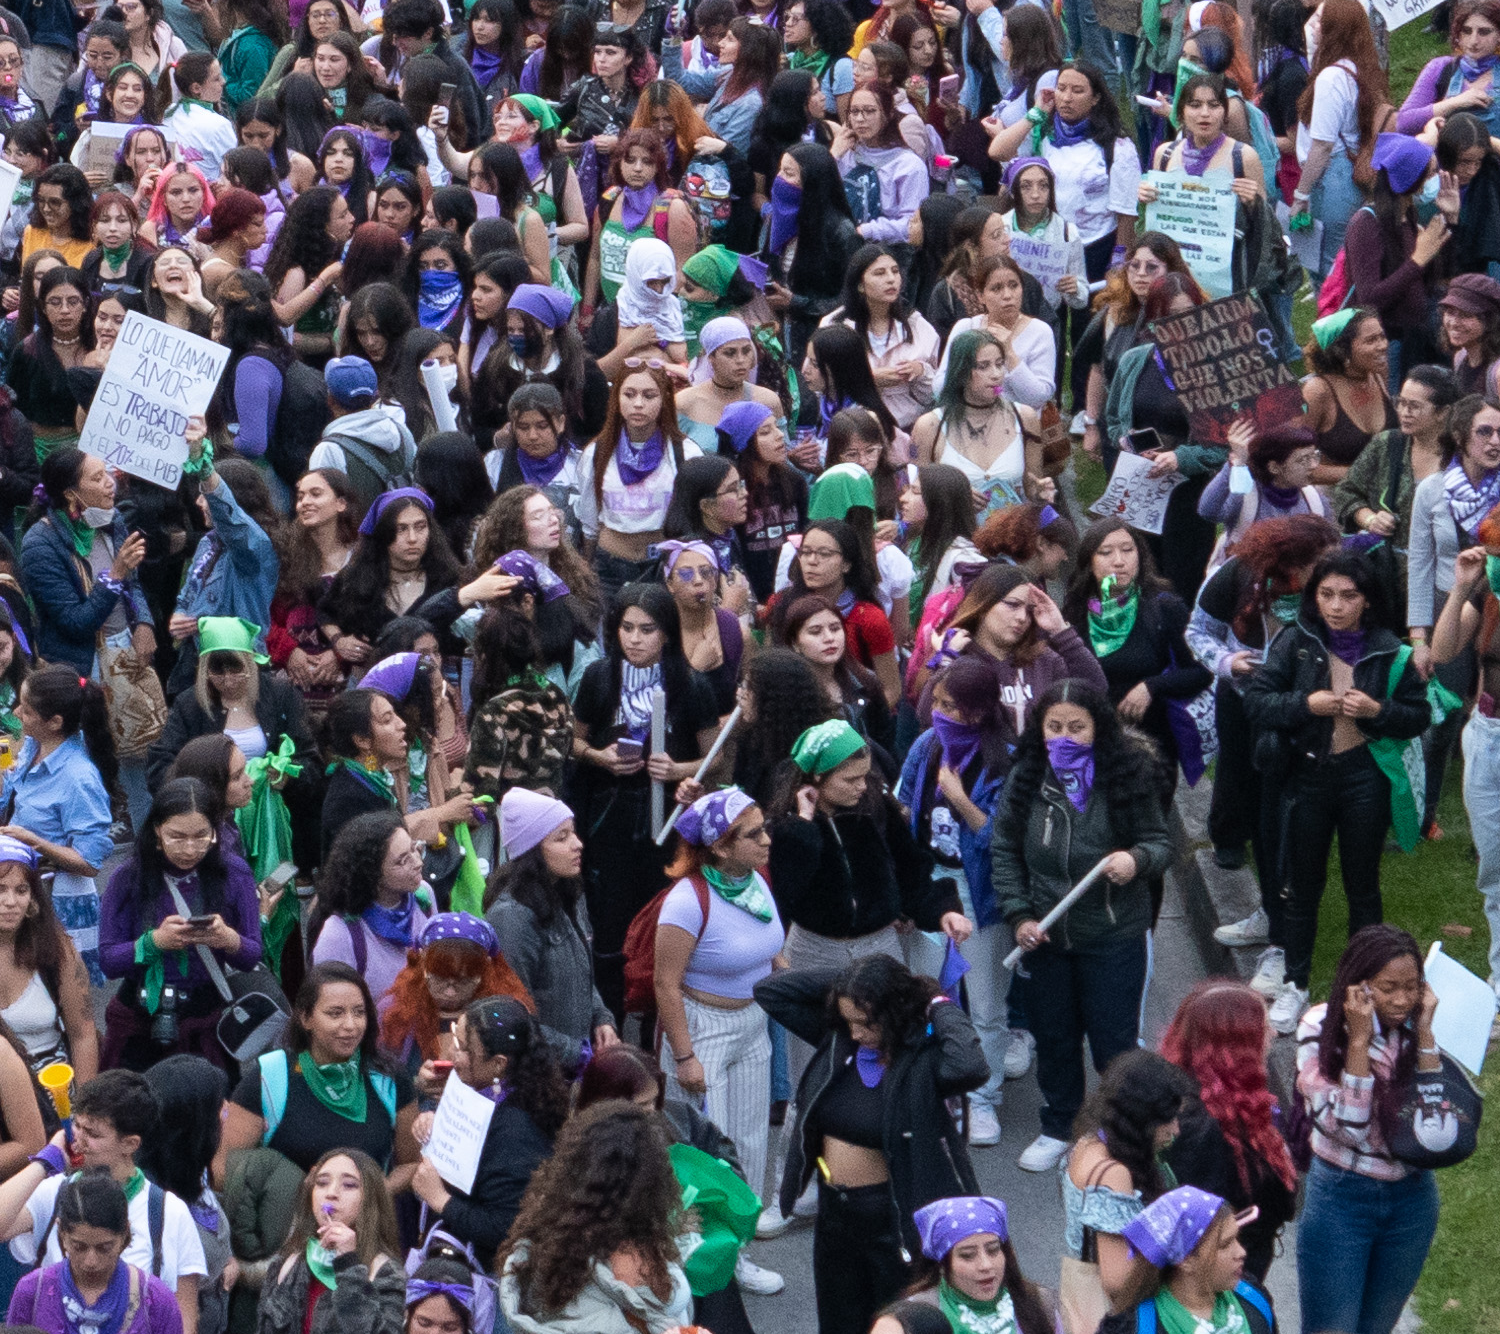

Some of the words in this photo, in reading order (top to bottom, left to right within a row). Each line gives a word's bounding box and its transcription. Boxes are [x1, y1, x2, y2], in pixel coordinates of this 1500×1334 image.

[119, 316, 144, 347] LO
[143, 326, 173, 359] QUE
[173, 339, 225, 383] LLAMAN
[99, 381, 120, 407] ES
[126, 390, 189, 437] TRABAJO
[103, 412, 131, 435] NO
[135, 423, 171, 451] PAGO
[87, 429, 97, 444] Y
[105, 440, 133, 467] 20%
[152, 458, 179, 485] PIB
